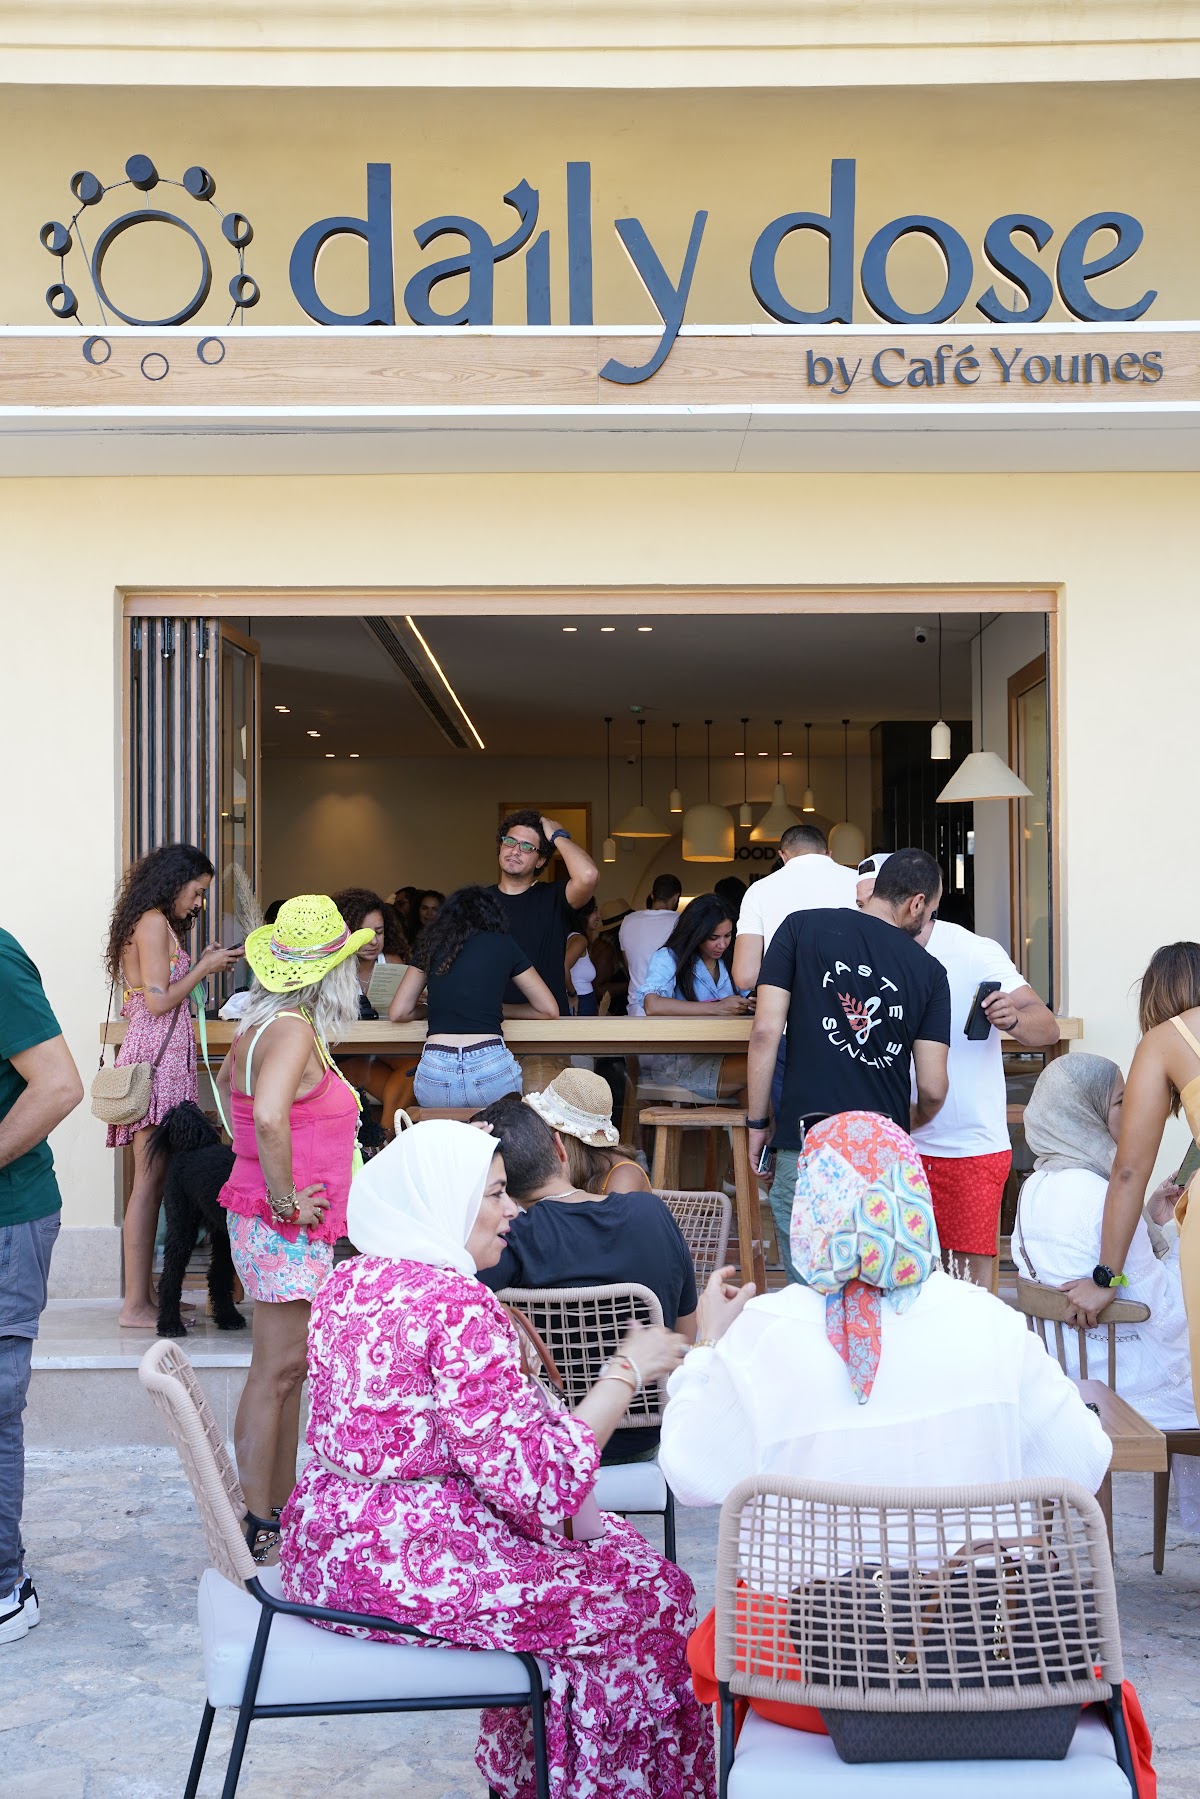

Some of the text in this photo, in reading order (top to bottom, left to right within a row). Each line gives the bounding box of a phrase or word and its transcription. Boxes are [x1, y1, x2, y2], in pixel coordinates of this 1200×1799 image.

[289, 158, 1158, 384] daily dose
[805, 344, 1164, 395] by Café Younes
[735, 847, 776, 860] OOD
[822, 960, 904, 1021] TASTE
